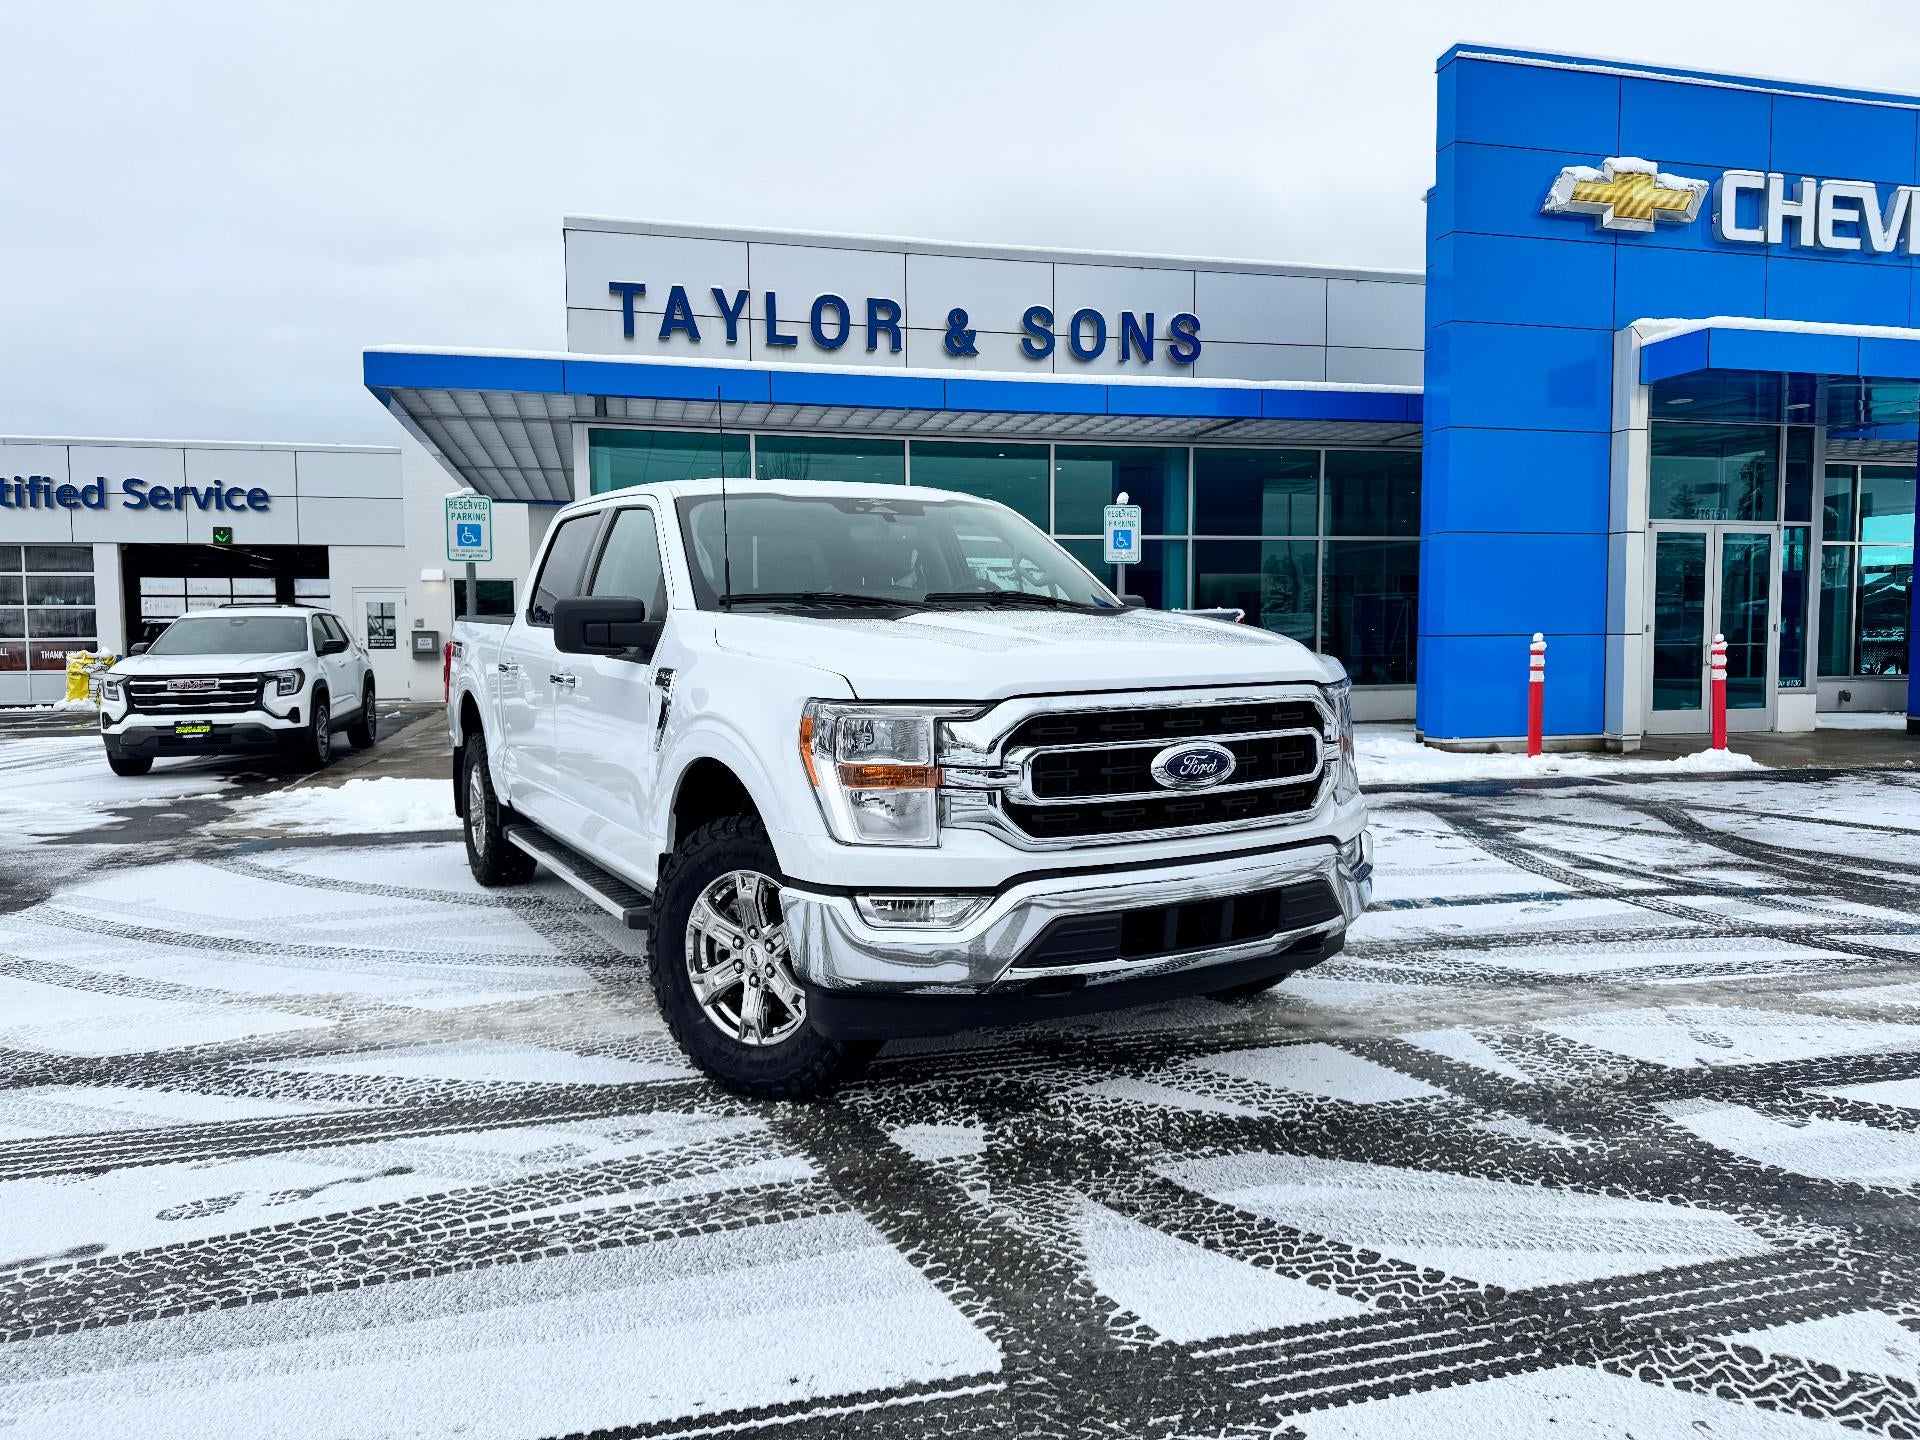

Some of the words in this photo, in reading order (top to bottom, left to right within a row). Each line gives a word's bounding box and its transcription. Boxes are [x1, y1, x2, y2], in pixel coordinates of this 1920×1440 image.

[1712, 170, 1920, 255] CHEV
[608, 281, 903, 353] TAYLOR
[943, 307, 979, 357] &
[1020, 305, 1201, 364] SONS
[0, 476, 107, 509] tified
[122, 478, 270, 511] Service
[448, 500, 488, 510] RESERVED
[451, 512, 486, 521] PARKING
[168, 679, 219, 690] GMC
[1180, 754, 1218, 775] Ford
